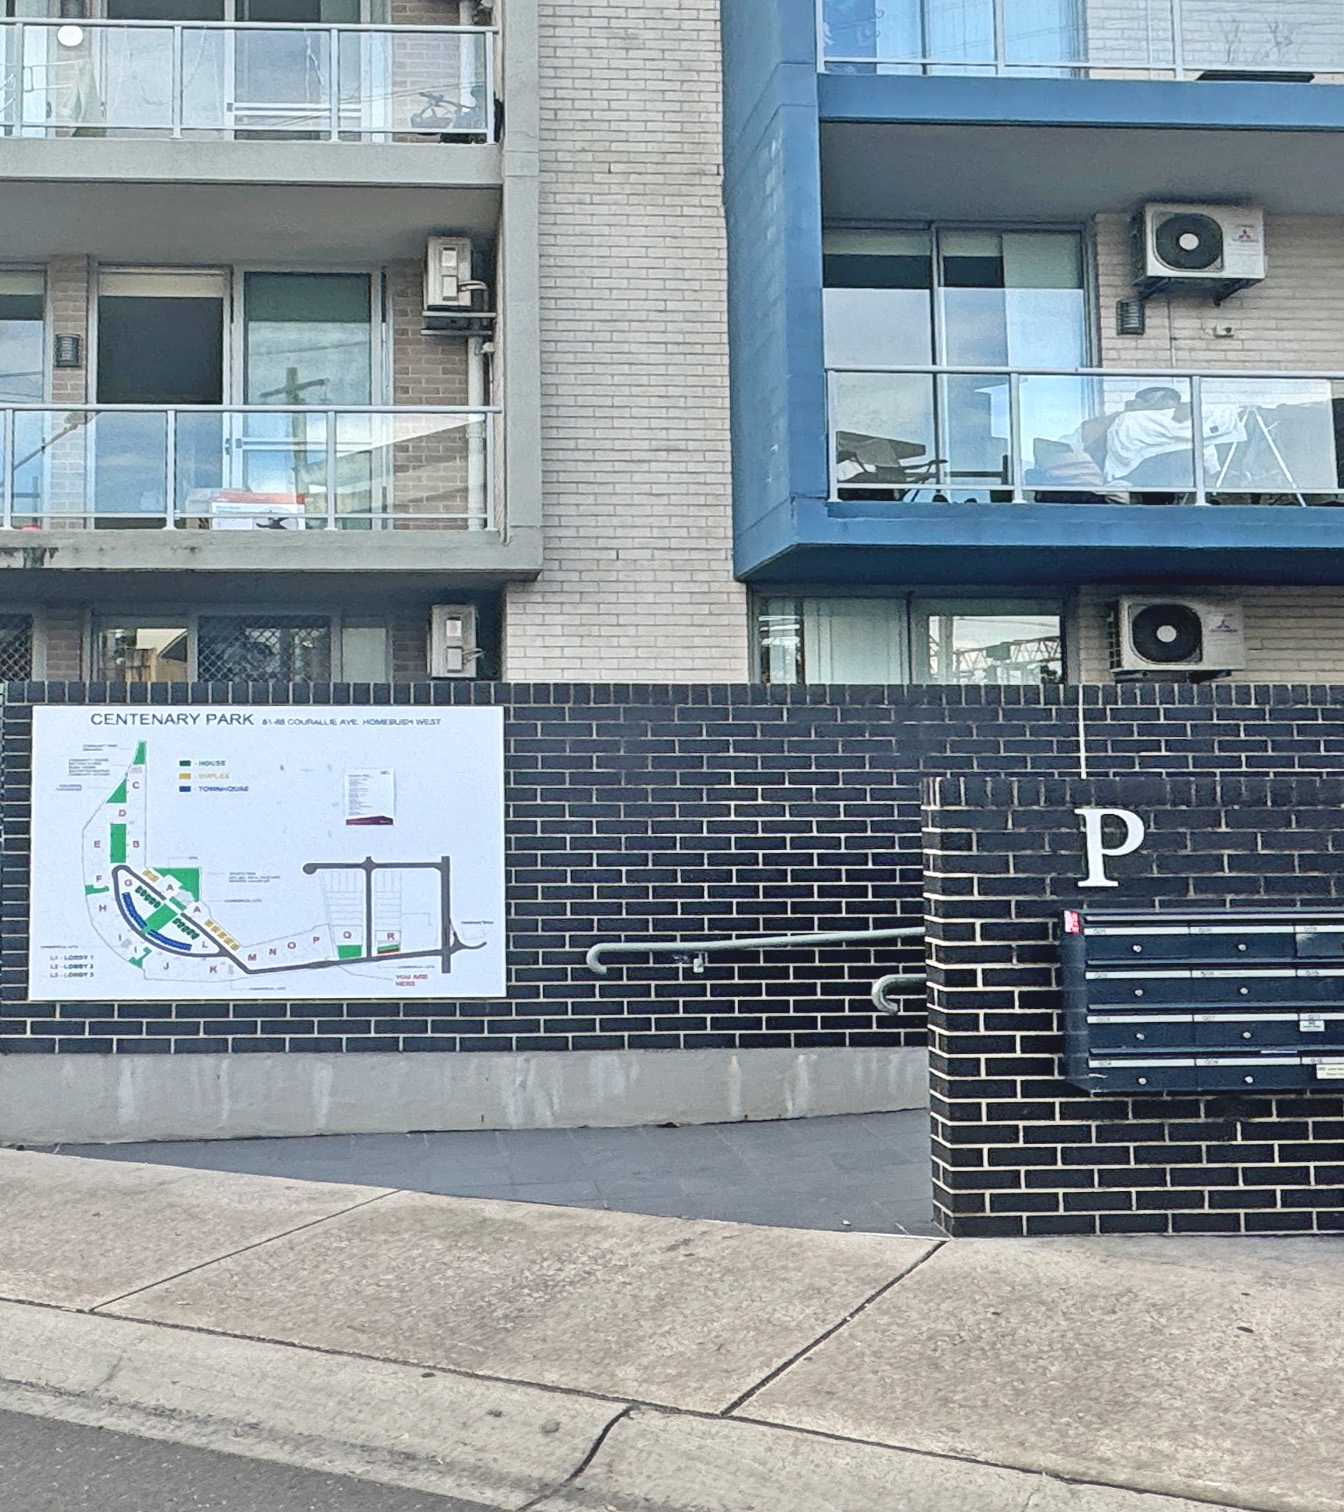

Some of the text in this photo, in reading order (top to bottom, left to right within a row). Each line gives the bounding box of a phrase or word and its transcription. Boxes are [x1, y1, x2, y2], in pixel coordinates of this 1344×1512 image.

[90, 713, 255, 726] CENTENARY PARK
[415, 718, 442, 726] WEST
[132, 781, 140, 790] C
[118, 809, 127, 817] D
[1074, 808, 1145, 887] P
[96, 875, 103, 883] F
[165, 883, 174, 891] A
[312, 936, 320, 944] P
[386, 932, 395, 941] R
[201, 940, 208, 948] L
[247, 953, 257, 961] M
[163, 962, 169, 970] J
[209, 965, 218, 974] K
